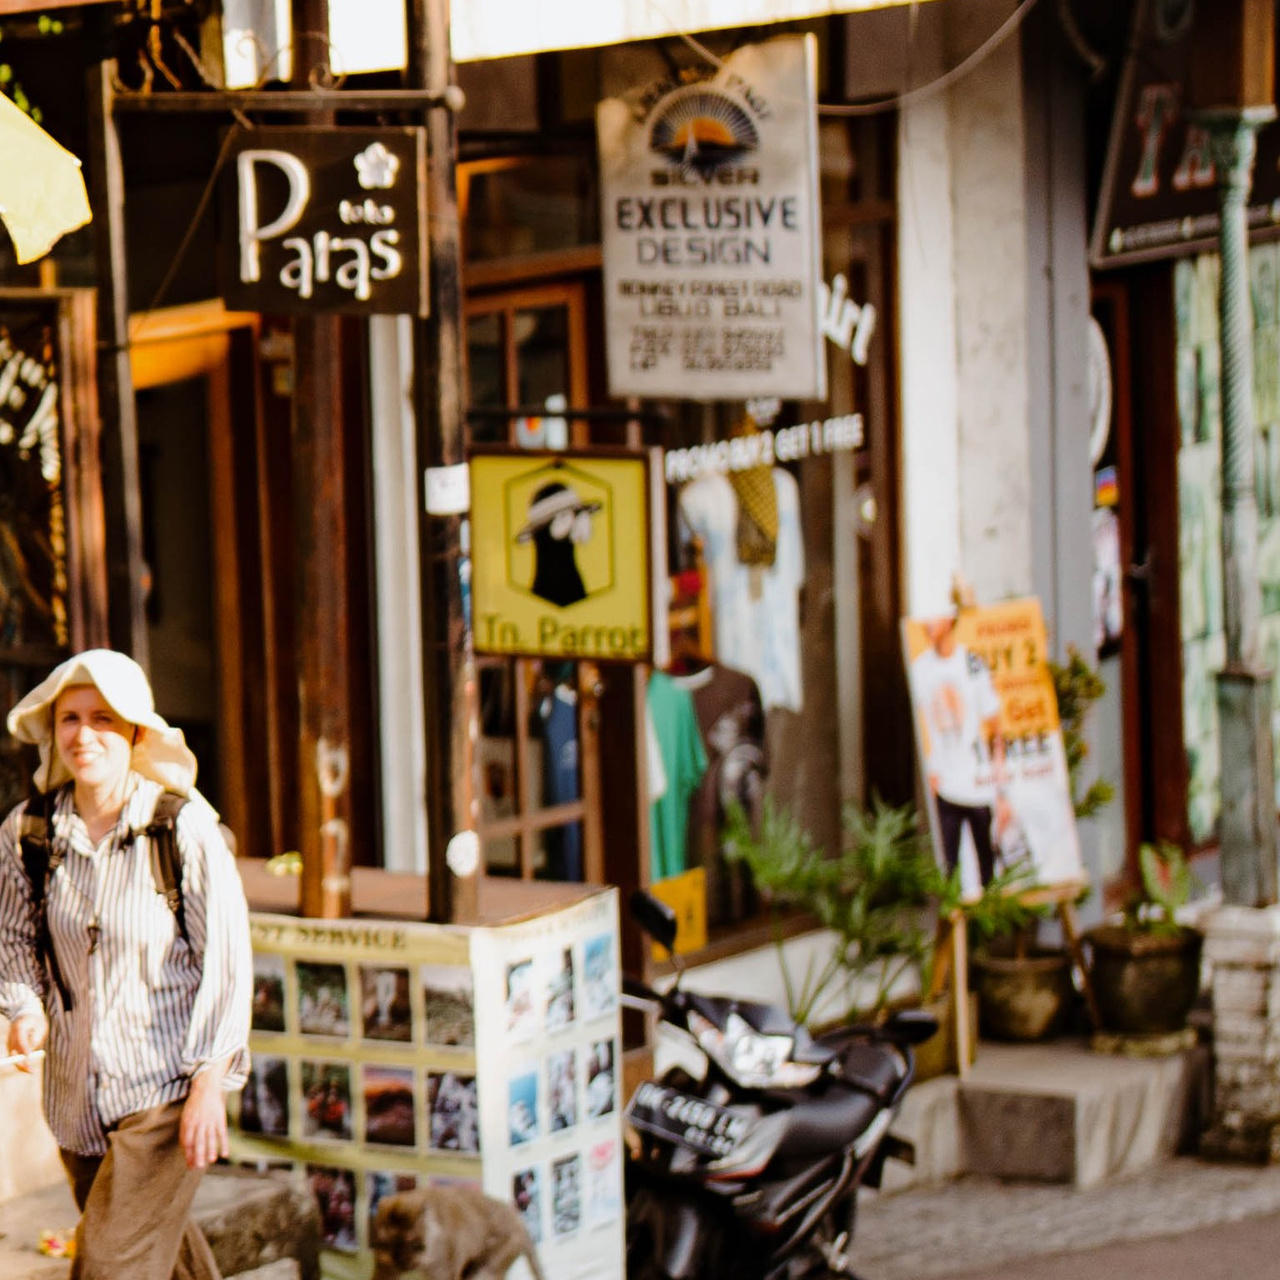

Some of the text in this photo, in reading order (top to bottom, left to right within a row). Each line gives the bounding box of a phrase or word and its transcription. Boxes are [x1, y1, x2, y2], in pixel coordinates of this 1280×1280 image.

[237, 150, 402, 300] Paras
[616, 195, 799, 231] EXCLUSIVE
[637, 235, 771, 265] DESIGN
[297, 924, 407, 950] SERVICE
